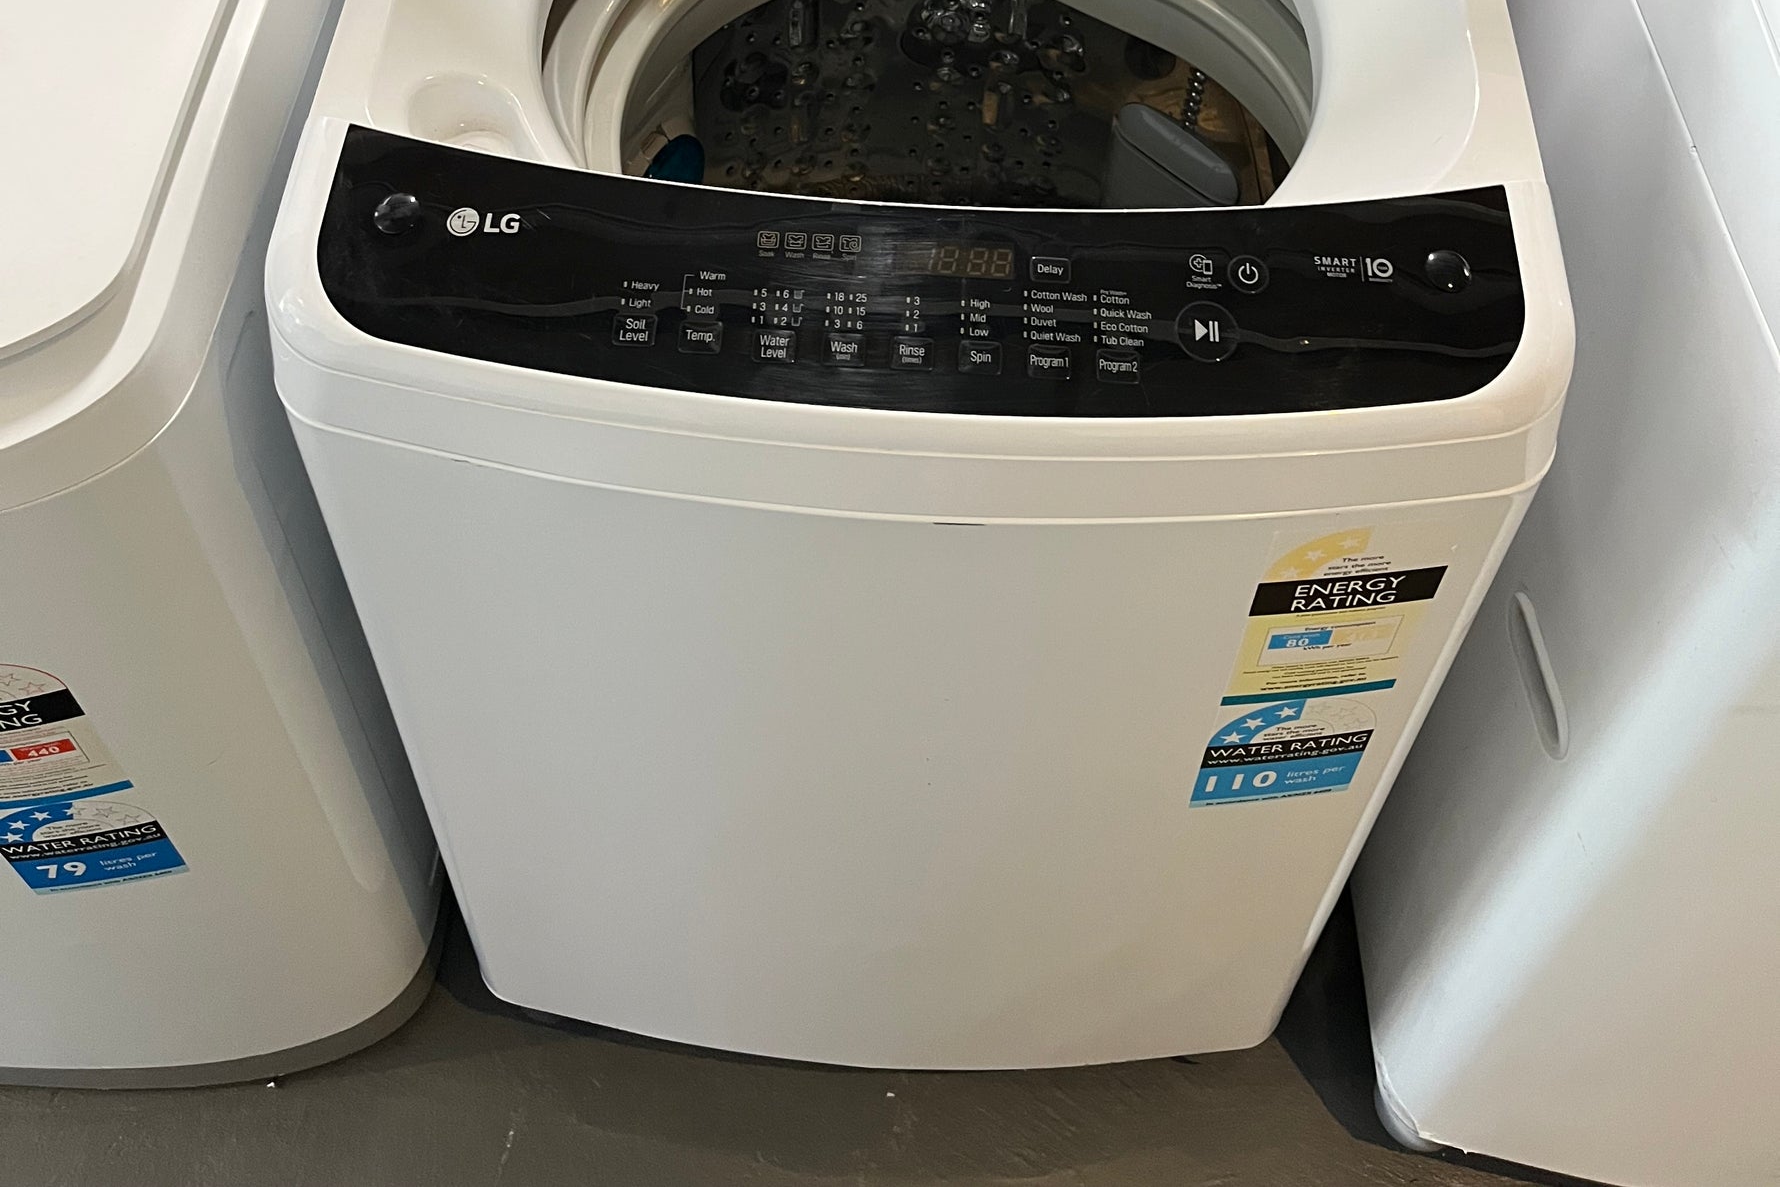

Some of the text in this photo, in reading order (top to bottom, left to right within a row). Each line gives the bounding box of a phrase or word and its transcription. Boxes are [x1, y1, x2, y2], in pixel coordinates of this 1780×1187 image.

[484, 213, 520, 233] LG
[1314, 256, 1357, 267] SMART
[699, 271, 726, 280] Warm
[1037, 264, 1064, 276] Delay
[631, 281, 660, 292] Heavy
[696, 288, 712, 297] Hot
[761, 289, 790, 298] 5 6
[834, 292, 867, 303] 18 25
[1031, 290, 1087, 302] Cotton Wash
[629, 298, 652, 308] Light
[914, 296, 921, 305] 3
[970, 299, 991, 309] High
[1100, 295, 1130, 305] Cotton
[695, 305, 714, 314] Cold
[759, 302, 789, 312] 3 4
[833, 306, 866, 316] 10 15
[1031, 304, 1054, 314] Wool
[913, 310, 920, 319] 2
[970, 314, 986, 323] Mid
[1100, 308, 1152, 320] Quick Wash
[625, 318, 646, 330] Soil
[780, 317, 787, 325] 2
[834, 320, 863, 329] 3 6
[1031, 317, 1057, 328] Duvet
[1100, 321, 1149, 333] Eco Cotton
[619, 330, 649, 342] Level
[686, 329, 715, 343] Temp.
[969, 327, 989, 337] Low
[1030, 331, 1081, 343] Quiet Wash
[759, 335, 789, 347] Water
[830, 341, 858, 353] Wash
[1101, 335, 1144, 347] Tub Clean
[761, 347, 787, 359] Level
[899, 344, 925, 356] Rinse
[970, 350, 991, 363] Spin
[1030, 355, 1064, 368] Program
[1099, 358, 1138, 373] Program 2
[1294, 575, 1406, 597] ENERGY
[1290, 590, 1398, 611] RATING
[1286, 638, 1310, 648] 80
[27, 745, 60, 757] 440
[1210, 733, 1368, 758] WATER RATING
[1207, 743, 1364, 765] www.waterrating.gov.au
[1286, 765, 1346, 778] litres per
[1204, 770, 1278, 793] 110
[1284, 775, 1316, 784] wash
[2, 825, 157, 854] WATER RATING
[9, 833, 161, 860] www.waterrating.gov.au
[99, 851, 158, 866] litres per
[36, 861, 87, 879] 79
[104, 861, 136, 872] wash
